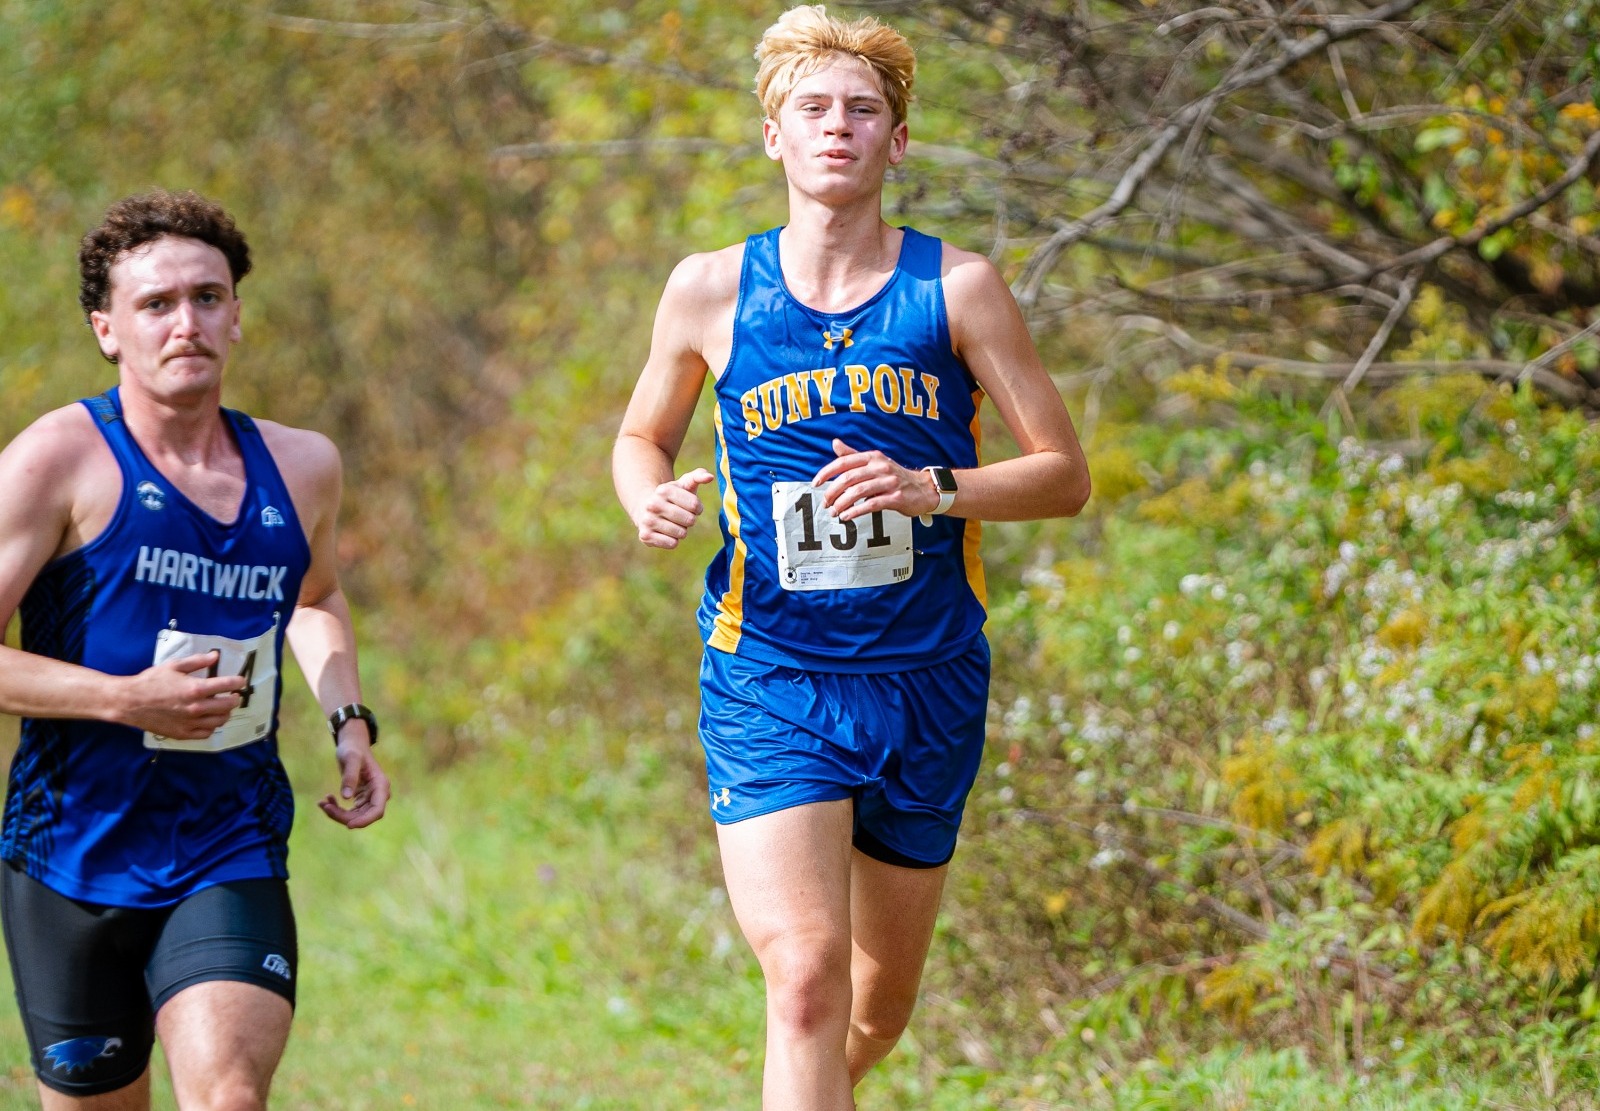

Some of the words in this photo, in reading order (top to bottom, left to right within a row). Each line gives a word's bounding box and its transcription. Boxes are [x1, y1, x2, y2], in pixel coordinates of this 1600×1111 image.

[740, 367, 837, 441] SUNY
[844, 364, 940, 420] POLY
[795, 493, 891, 551] 131
[135, 545, 289, 601] HARTWICK
